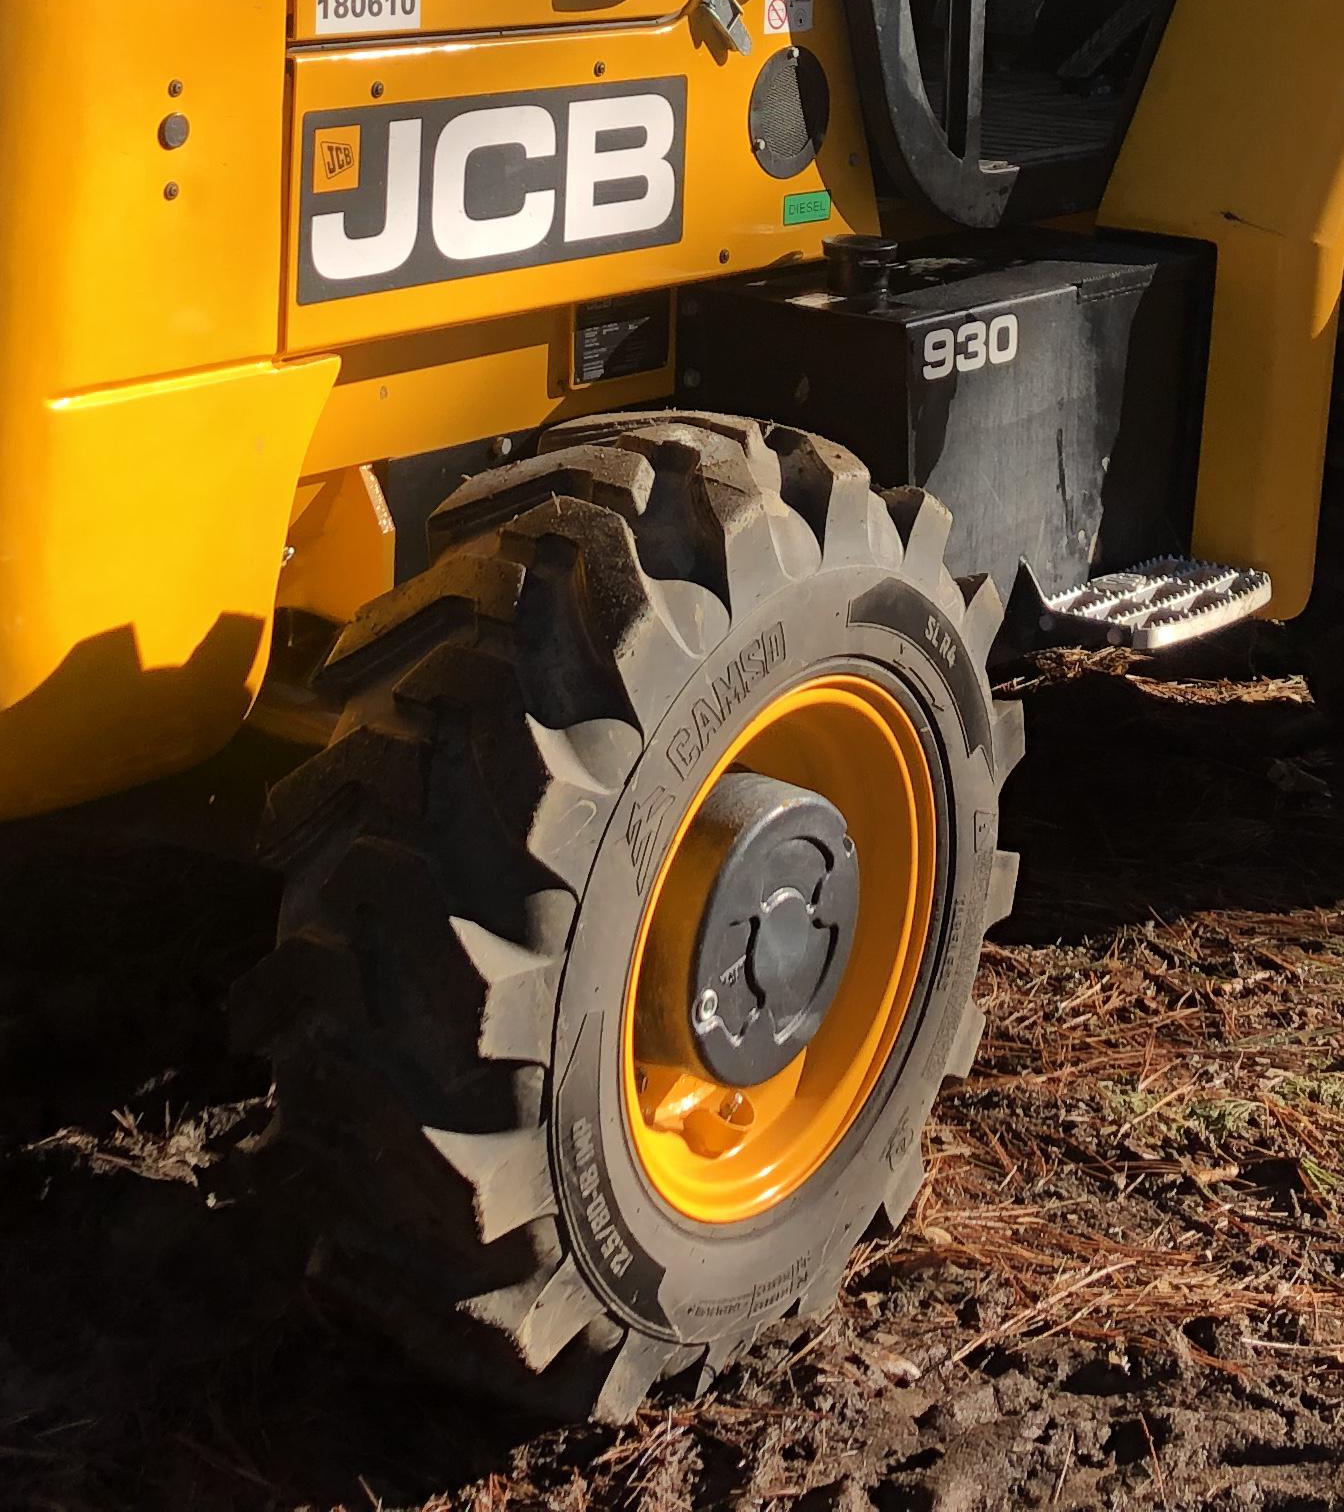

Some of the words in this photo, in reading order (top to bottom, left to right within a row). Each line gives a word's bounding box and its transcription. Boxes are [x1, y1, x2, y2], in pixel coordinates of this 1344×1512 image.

[327, 145, 353, 174] JCB
[311, 93, 675, 280] JCB
[788, 200, 827, 216] DIESEL
[922, 313, 1018, 380] 930
